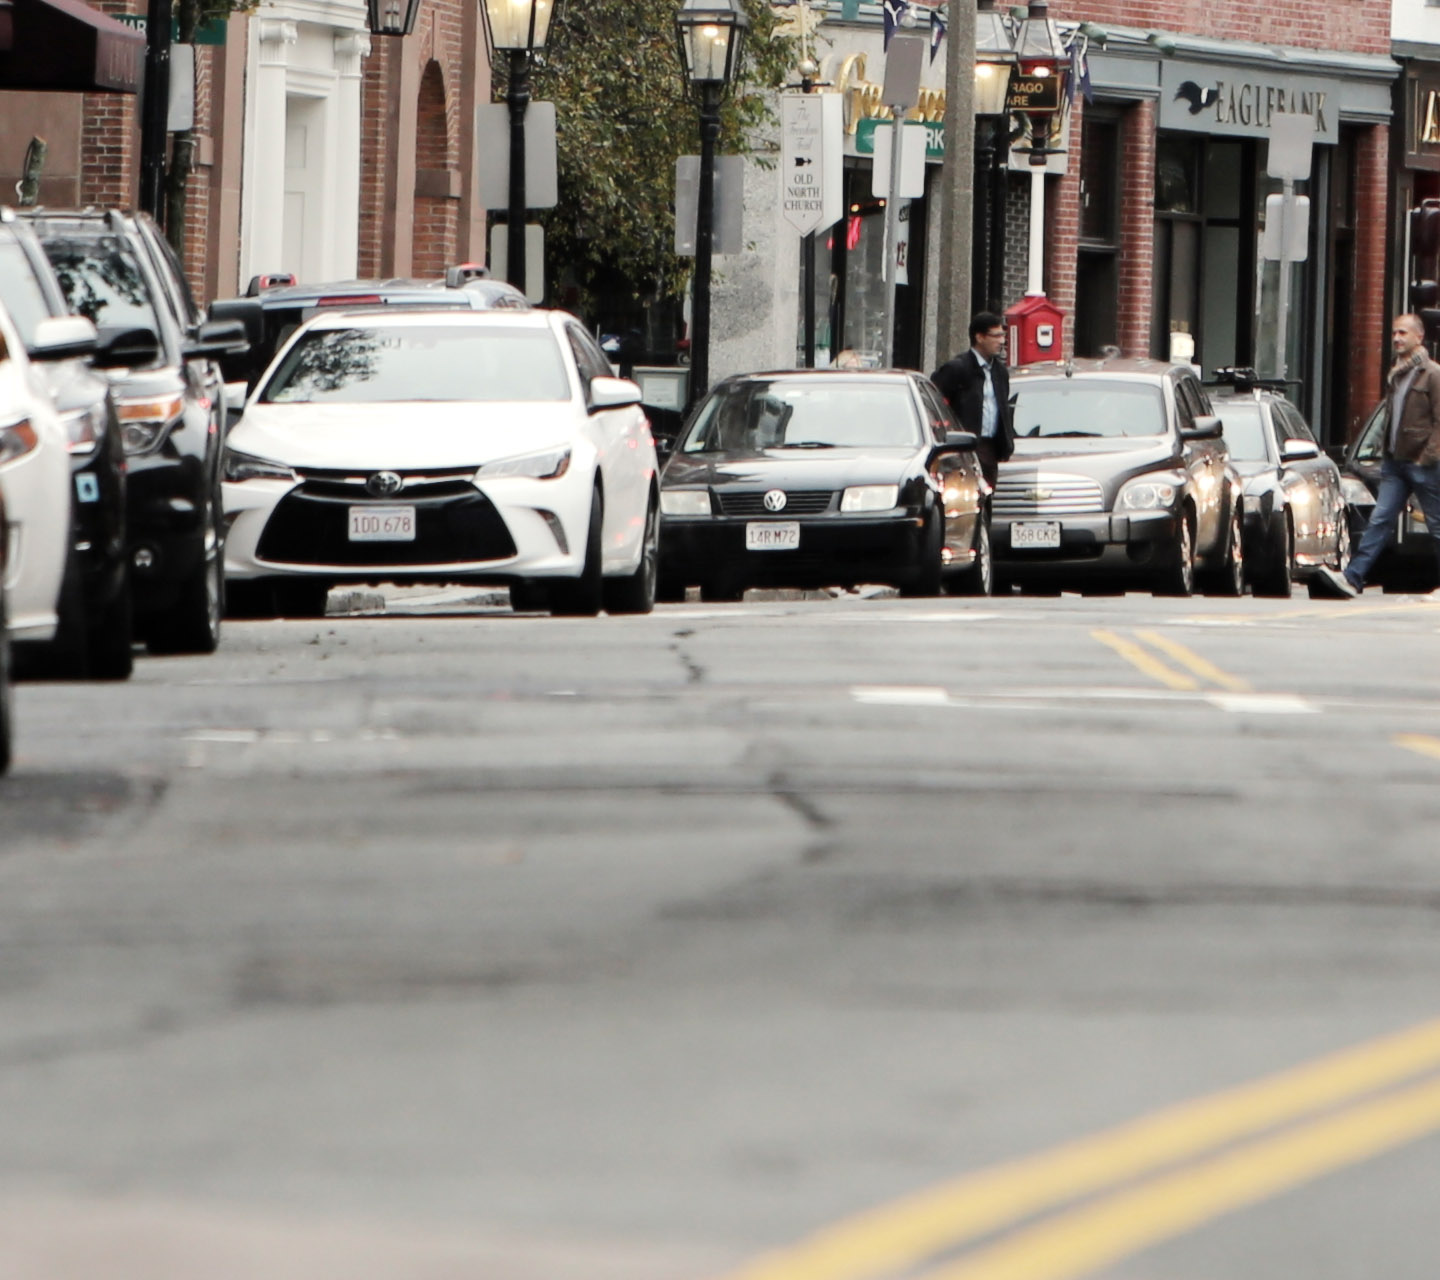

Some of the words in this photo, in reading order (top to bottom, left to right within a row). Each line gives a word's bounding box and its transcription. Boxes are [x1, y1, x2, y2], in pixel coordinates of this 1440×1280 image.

[794, 174, 813, 185] OLD
[787, 187, 820, 198] NORTH
[784, 201, 822, 211] CHURCH
[384, 516, 411, 534] 678
[774, 529, 797, 544] M72
